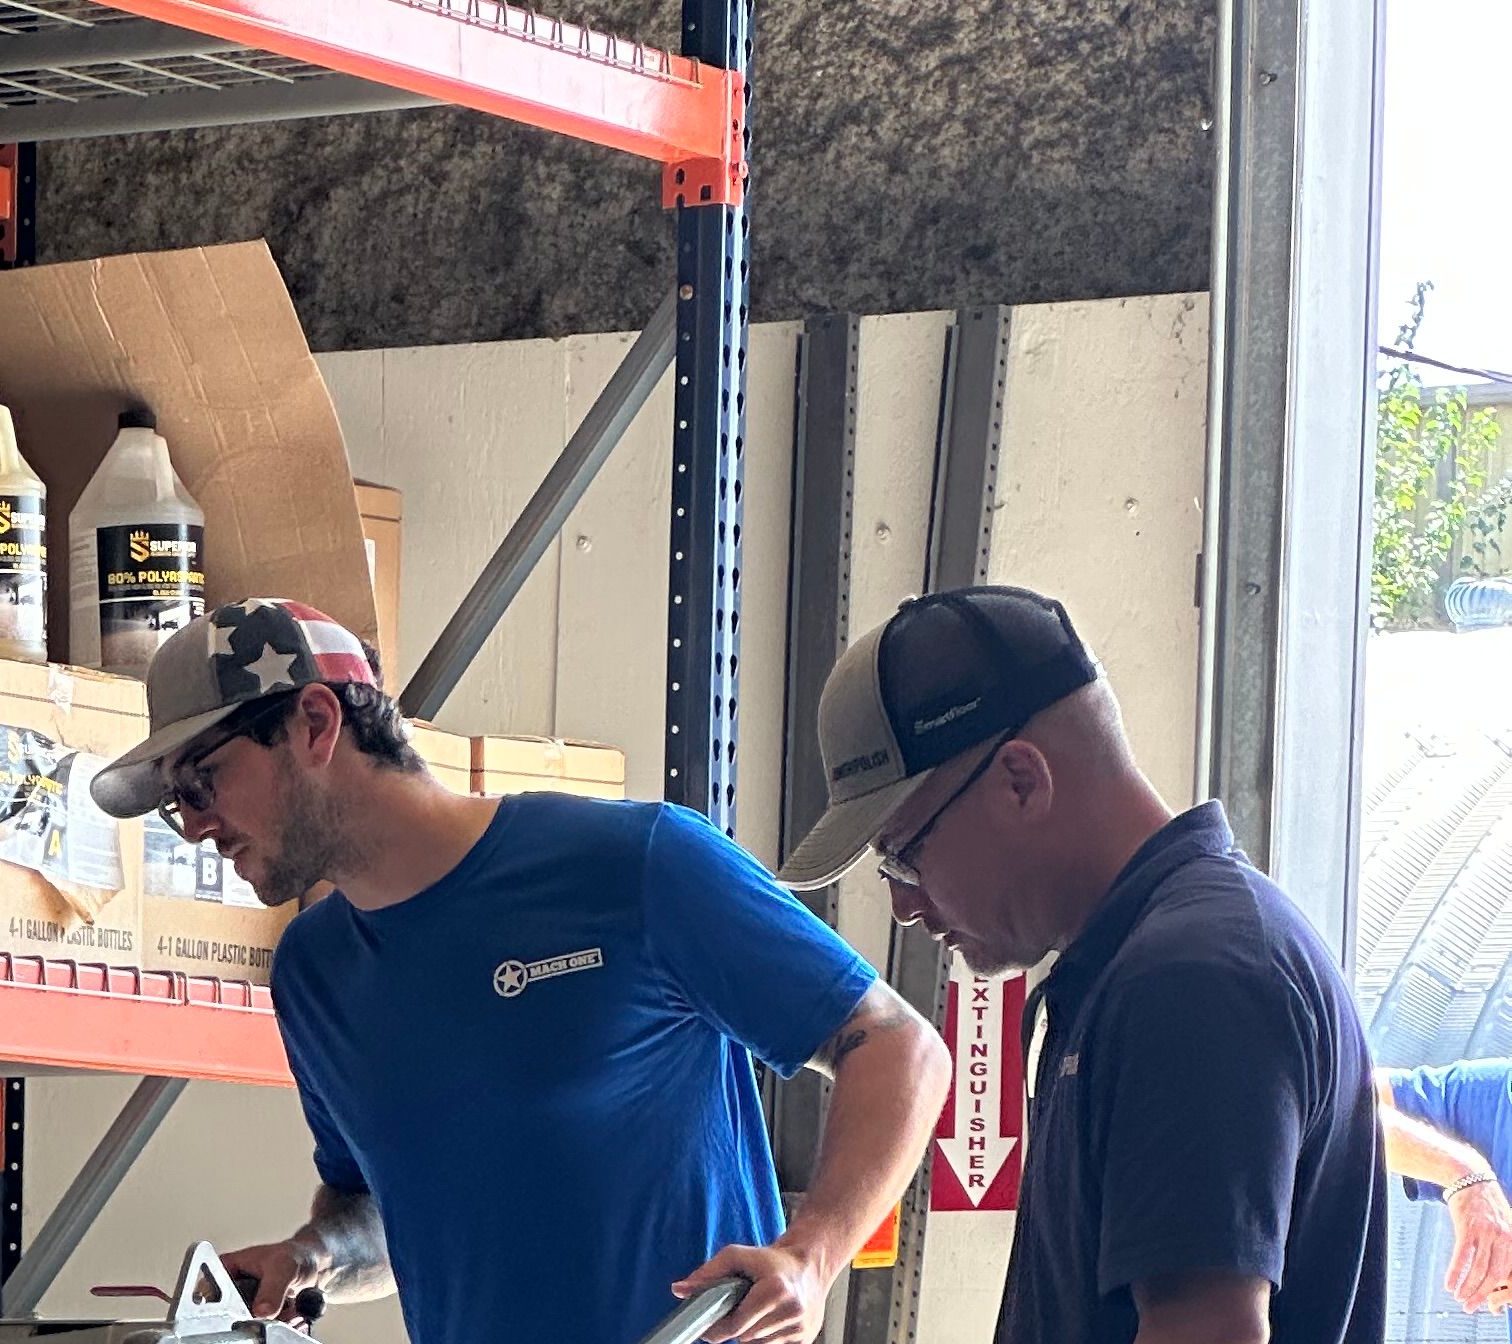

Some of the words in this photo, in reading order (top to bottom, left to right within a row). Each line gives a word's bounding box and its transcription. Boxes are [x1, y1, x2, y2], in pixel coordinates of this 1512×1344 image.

[203, 857, 217, 885] B
[9, 917, 23, 937] 4-1
[26, 920, 59, 943] GALLON
[98, 927, 133, 951] BOTTLES
[157, 936, 173, 955] 4-1
[176, 937, 209, 961] GALLON
[211, 942, 247, 966] PLASTIC
[249, 946, 272, 969] BOTT
[530, 960, 567, 977] MACH
[569, 953, 598, 968] ONE
